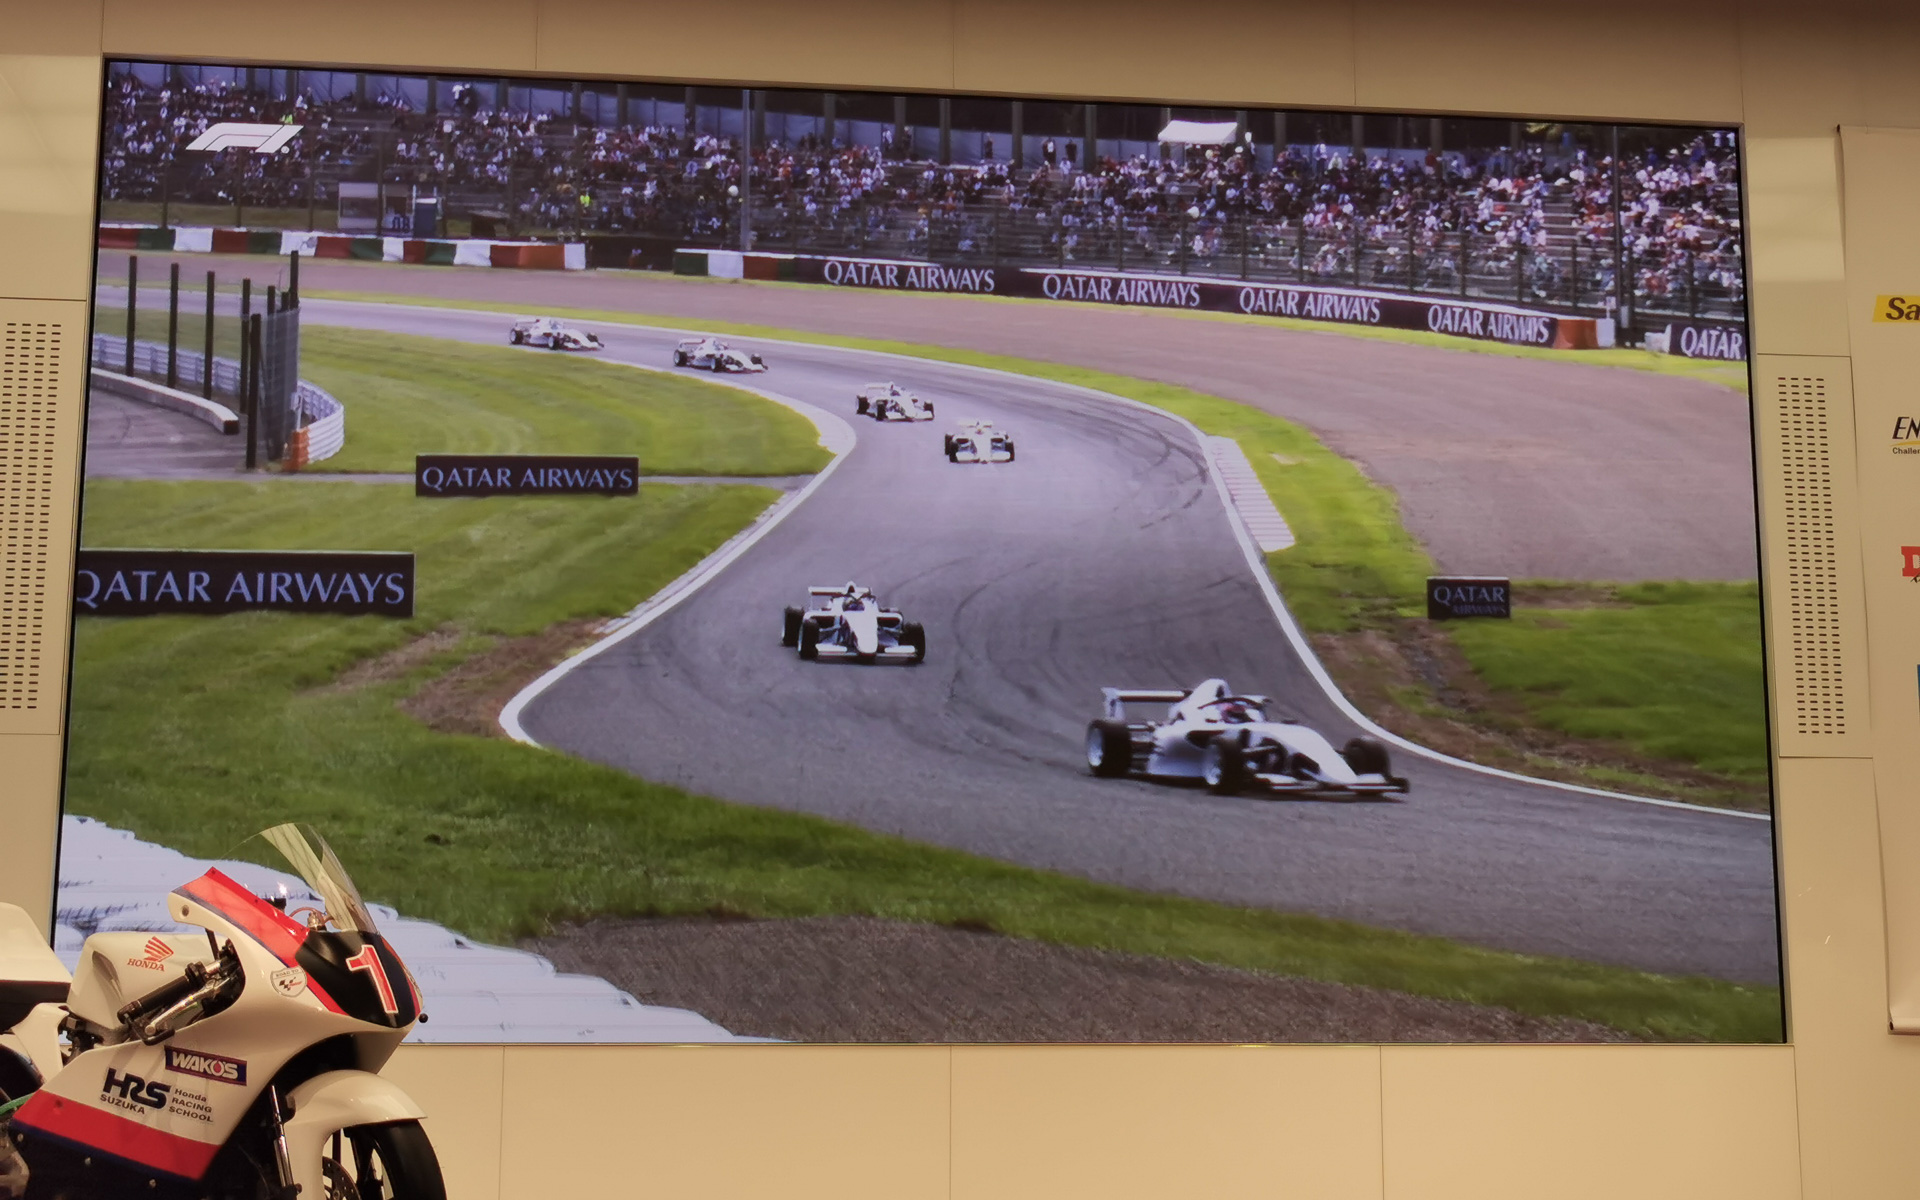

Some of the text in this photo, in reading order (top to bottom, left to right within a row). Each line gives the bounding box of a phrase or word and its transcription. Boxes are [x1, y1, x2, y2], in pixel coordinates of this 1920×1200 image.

[823, 260, 995, 293] QATAR AIRWAYS
[1042, 274, 1201, 307] QATAR AIRWAYS
[1239, 287, 1381, 323] QATAR AIRWAYS
[1427, 304, 1550, 344] QATAR AIRWAYS
[1680, 326, 1743, 360] QATAR
[422, 466, 633, 493] QATAR AIRWAYS
[76, 570, 405, 609] QATAR AIRWAYS
[1433, 586, 1505, 606] QATAR
[127, 958, 165, 972] HONDA
[345, 944, 399, 1014] 1
[100, 1093, 145, 1115] SUZUKA
[102, 1067, 172, 1110] HRS
[171, 1096, 213, 1113] RACING
[174, 1088, 207, 1103] Honda
[168, 1105, 214, 1123] SCHOOL
